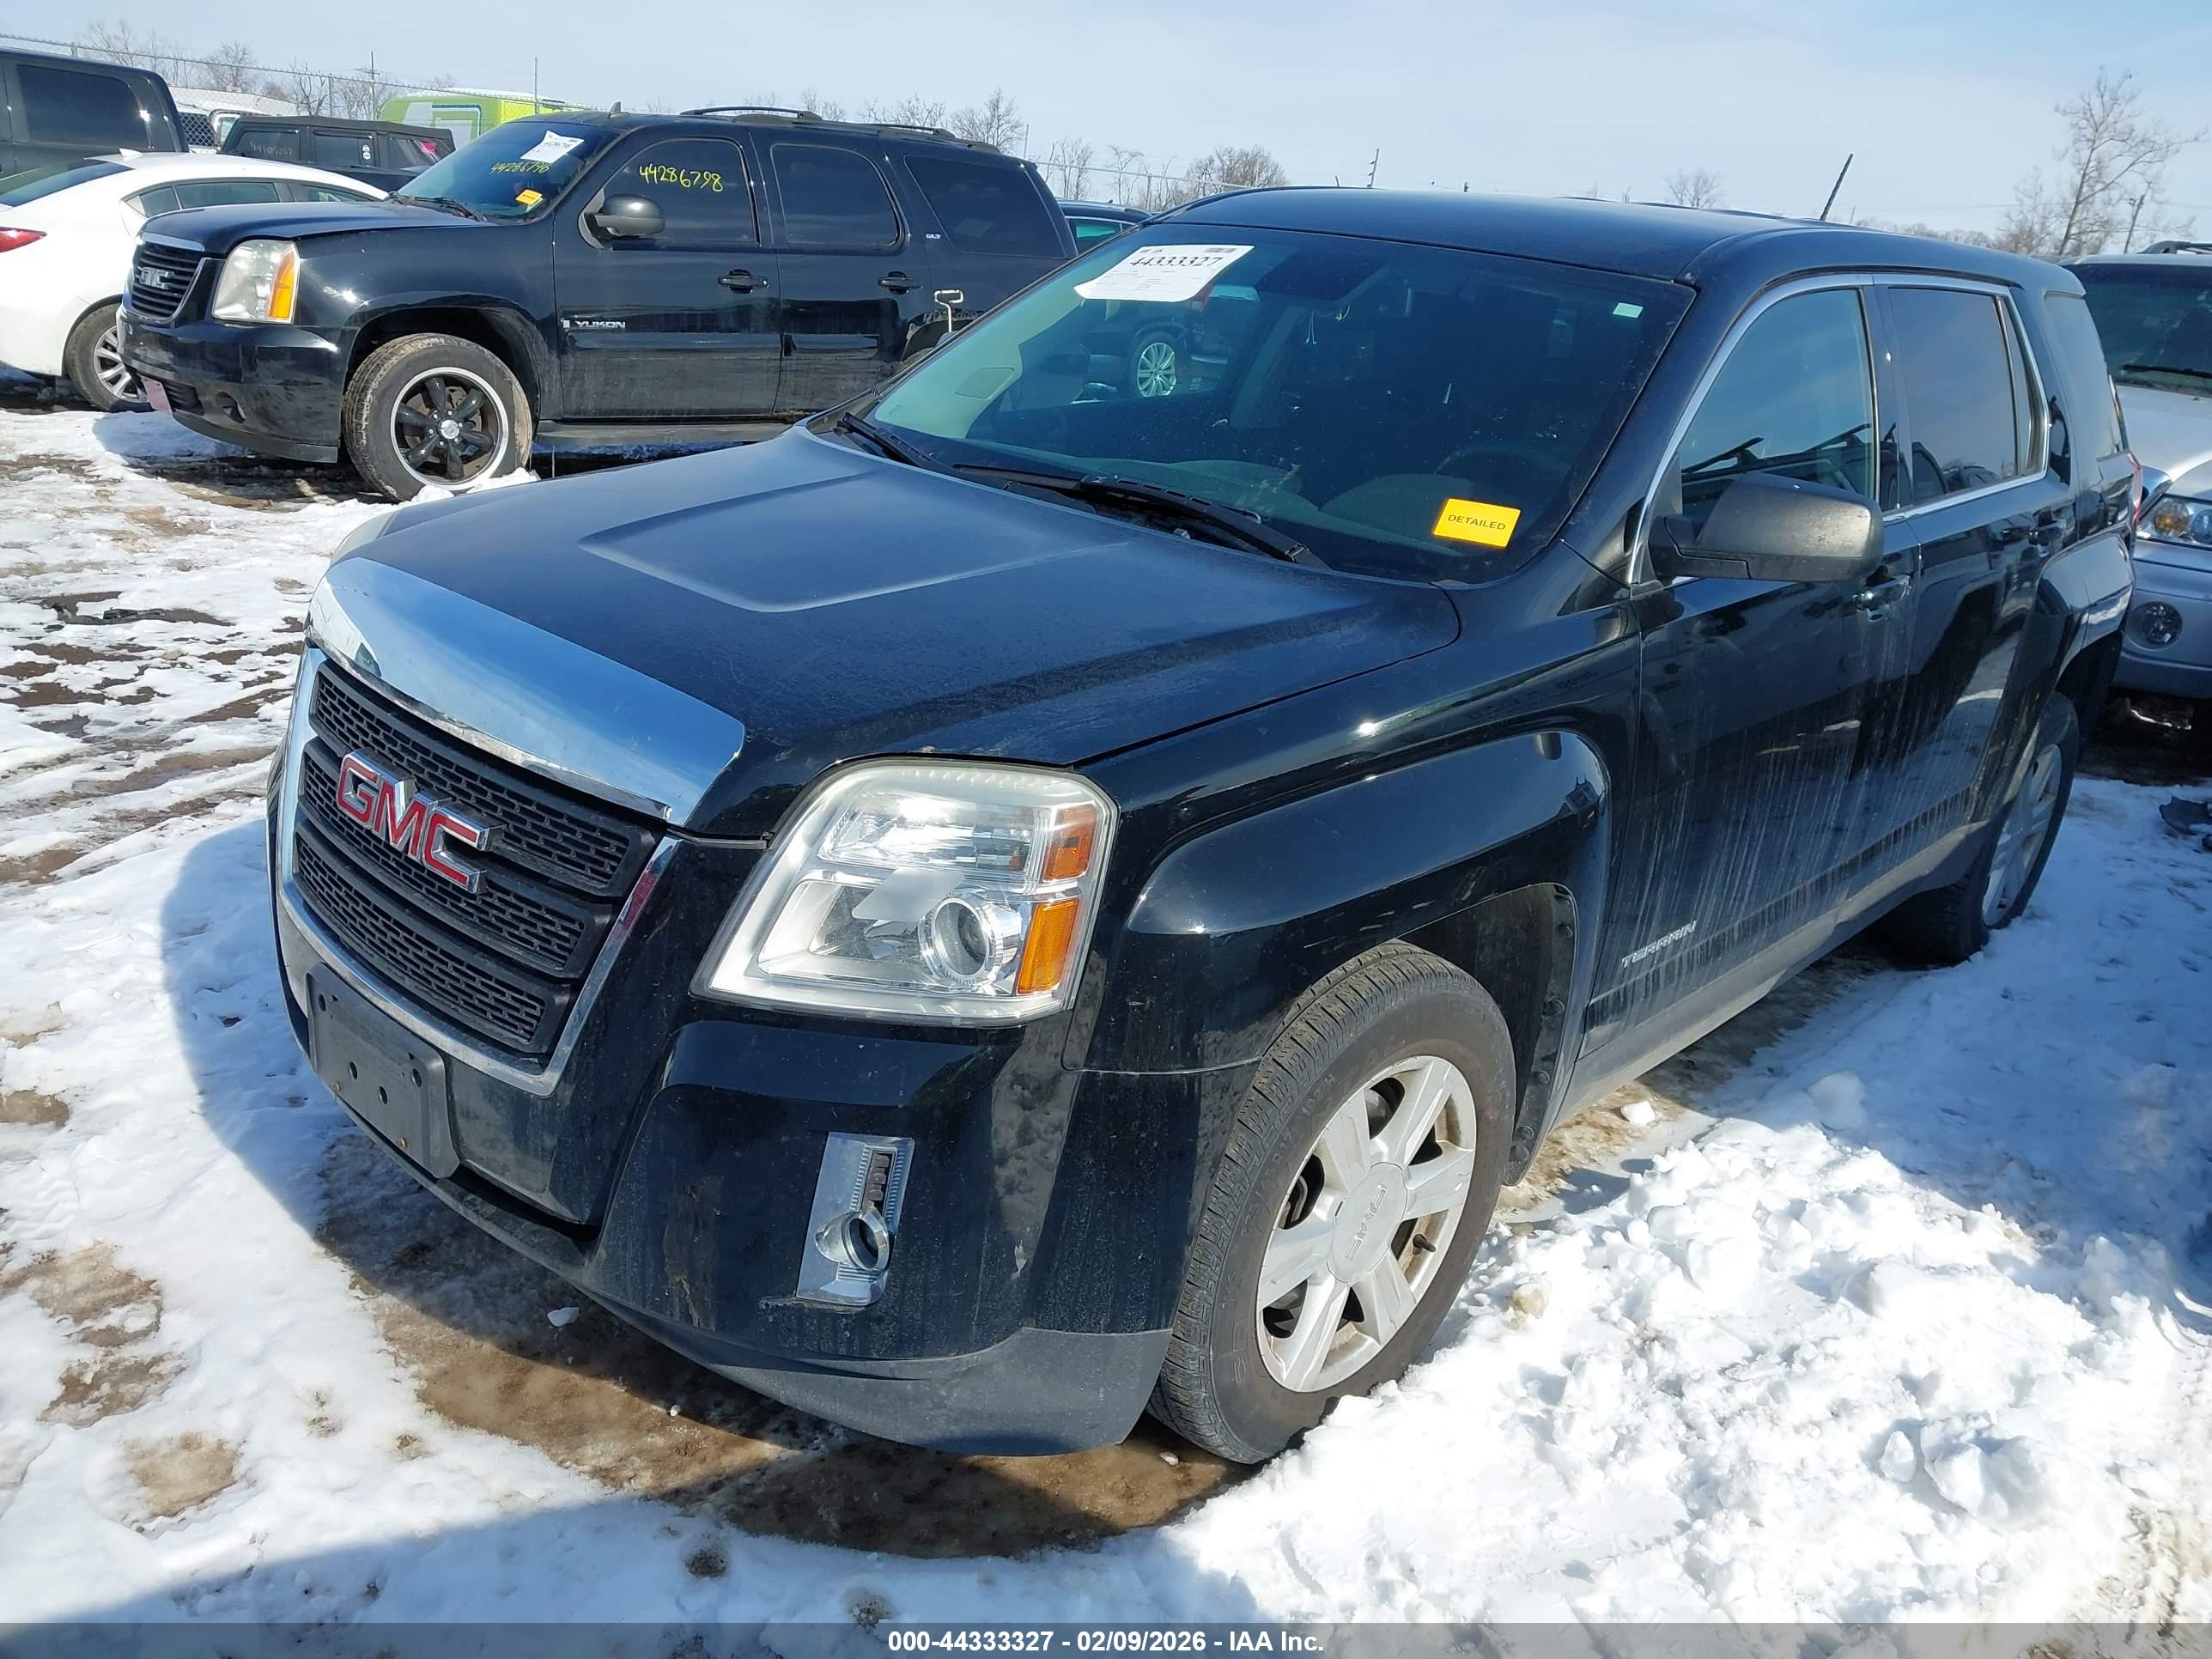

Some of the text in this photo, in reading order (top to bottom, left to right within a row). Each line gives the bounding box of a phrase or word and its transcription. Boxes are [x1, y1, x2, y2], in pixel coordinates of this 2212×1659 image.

[639, 163, 723, 191] 44286798
[1129, 256, 1224, 267] 44333327
[574, 320, 626, 329] YUKON
[1448, 514, 1506, 531] DETAILED
[336, 748, 494, 894] GMC
[1622, 921, 1697, 969] TERRAIN
[1346, 1185, 1388, 1261] GMC
